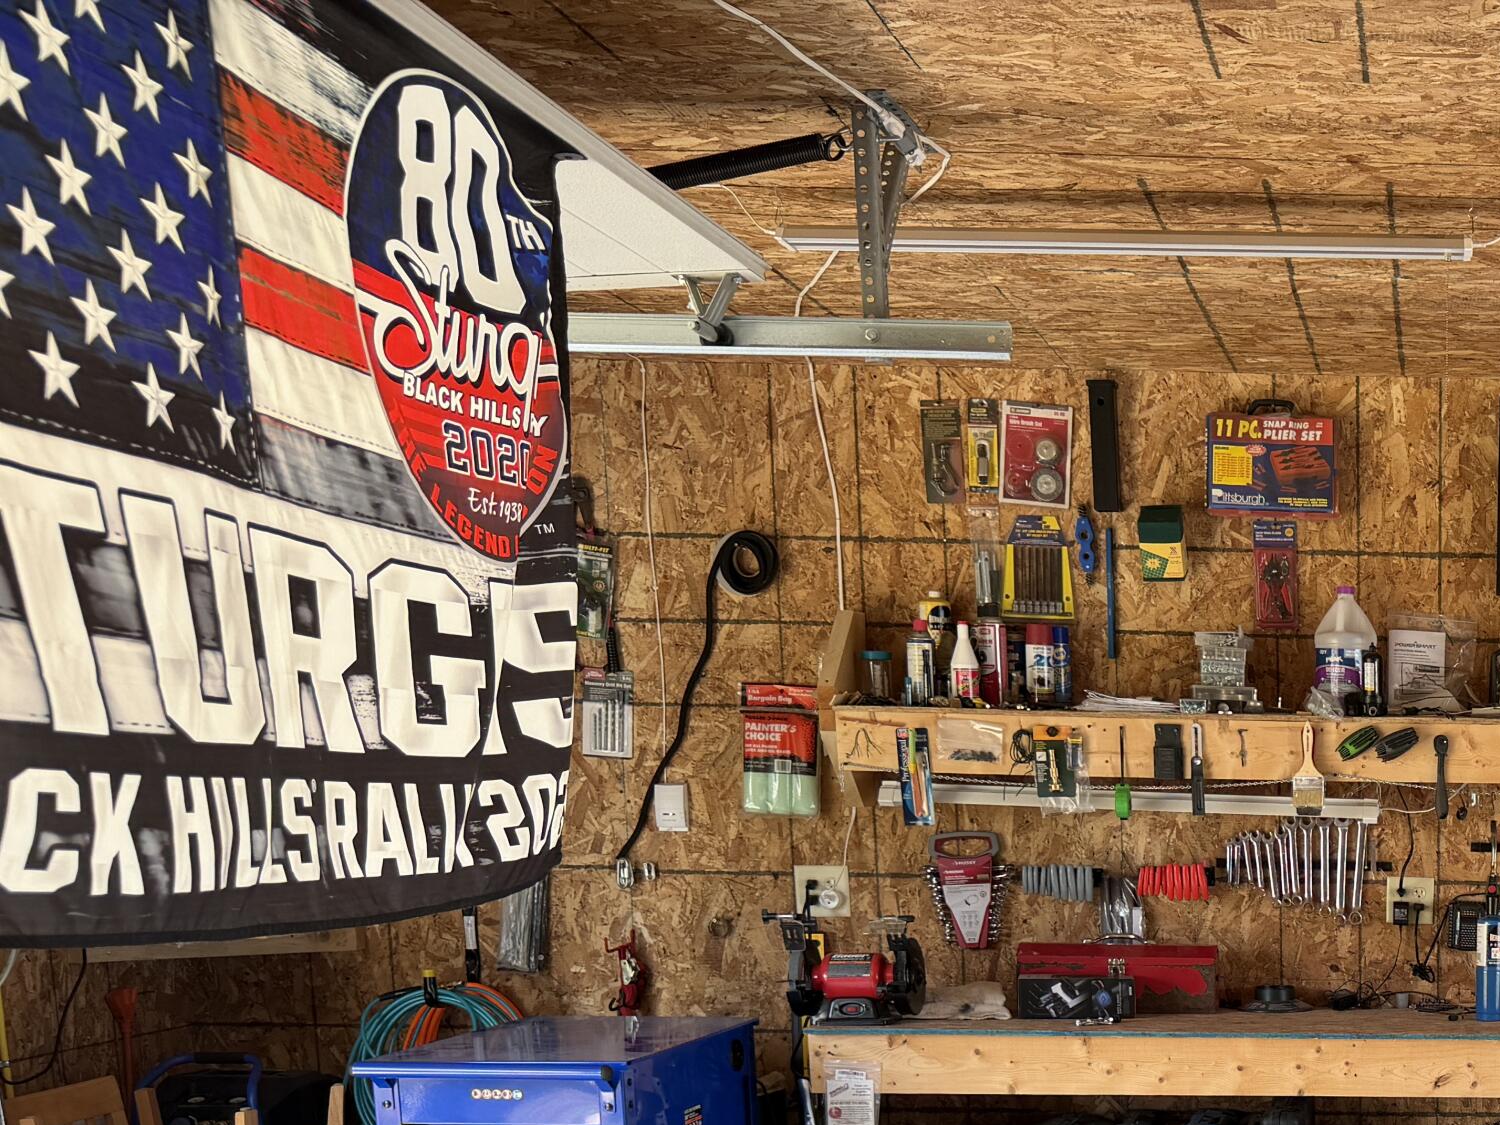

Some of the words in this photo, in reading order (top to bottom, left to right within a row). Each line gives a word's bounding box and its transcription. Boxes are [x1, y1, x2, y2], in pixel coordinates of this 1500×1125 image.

[397, 84, 527, 315] 80
[506, 213, 540, 251] TH
[403, 372, 463, 415] BLACK
[469, 394, 520, 429] HILLS
[1216, 419, 1233, 437] 11
[1238, 420, 1262, 439] PC.
[1263, 420, 1286, 428] SNAP
[1289, 421, 1309, 429] RING
[1263, 429, 1297, 440] PLIER
[1301, 430, 1323, 441] SET
[468, 487, 498, 518] Est.
[1212, 488, 1266, 506] Pittsburgh
[431, 484, 510, 558] LEGEND
[534, 522, 555, 536] TM
[745, 722, 797, 734] PAINTER'S
[745, 731, 782, 742] CHOICE
[165, 776, 320, 894] HILLS
